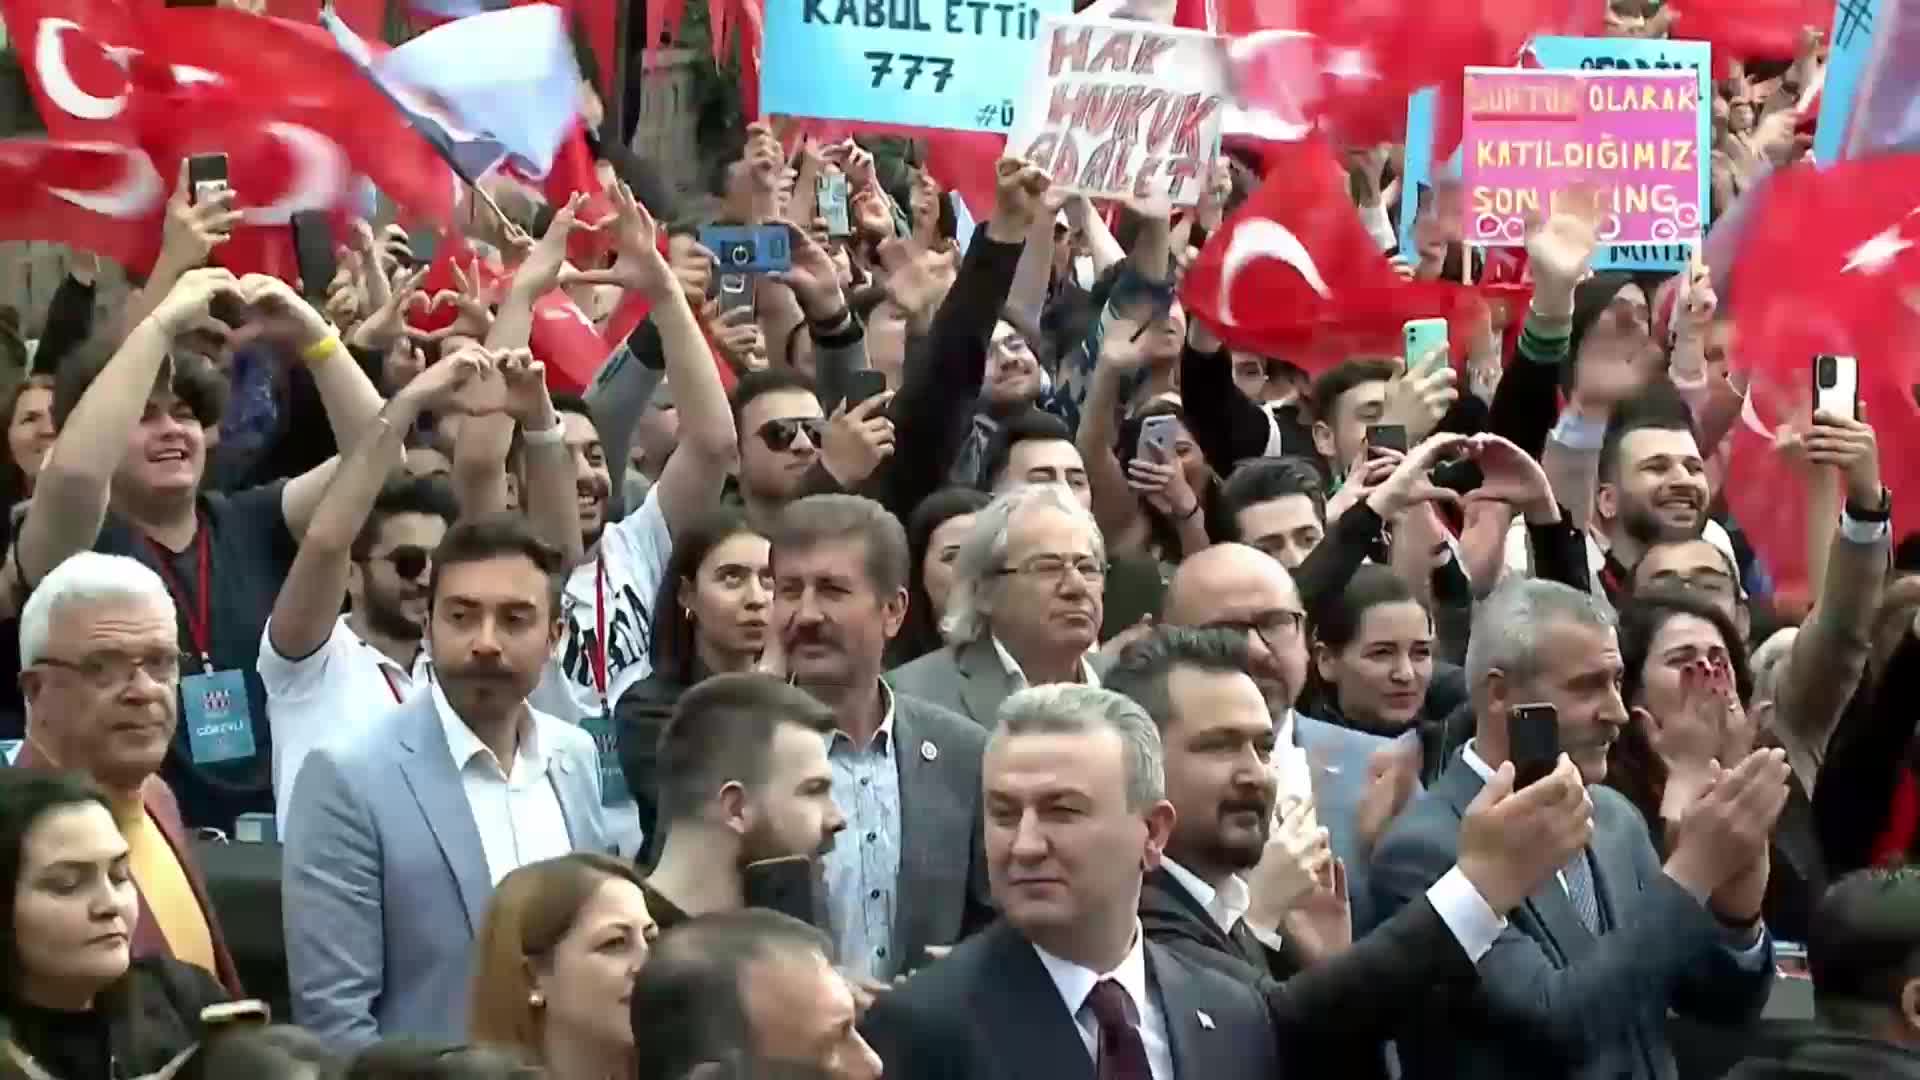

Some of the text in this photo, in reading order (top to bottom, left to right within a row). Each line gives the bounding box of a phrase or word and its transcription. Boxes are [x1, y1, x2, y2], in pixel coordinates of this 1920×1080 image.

[802, 0, 931, 31] KABUL
[1048, 25, 1177, 77] HAK
[864, 51, 954, 93] 777
[1589, 84, 1697, 112] OLARAK
[1048, 82, 1221, 160] HUKUK
[1024, 130, 1203, 199] ADALET
[1477, 132, 1694, 171] KATILDIĞIMIZ
[1472, 186, 1539, 214] SON
